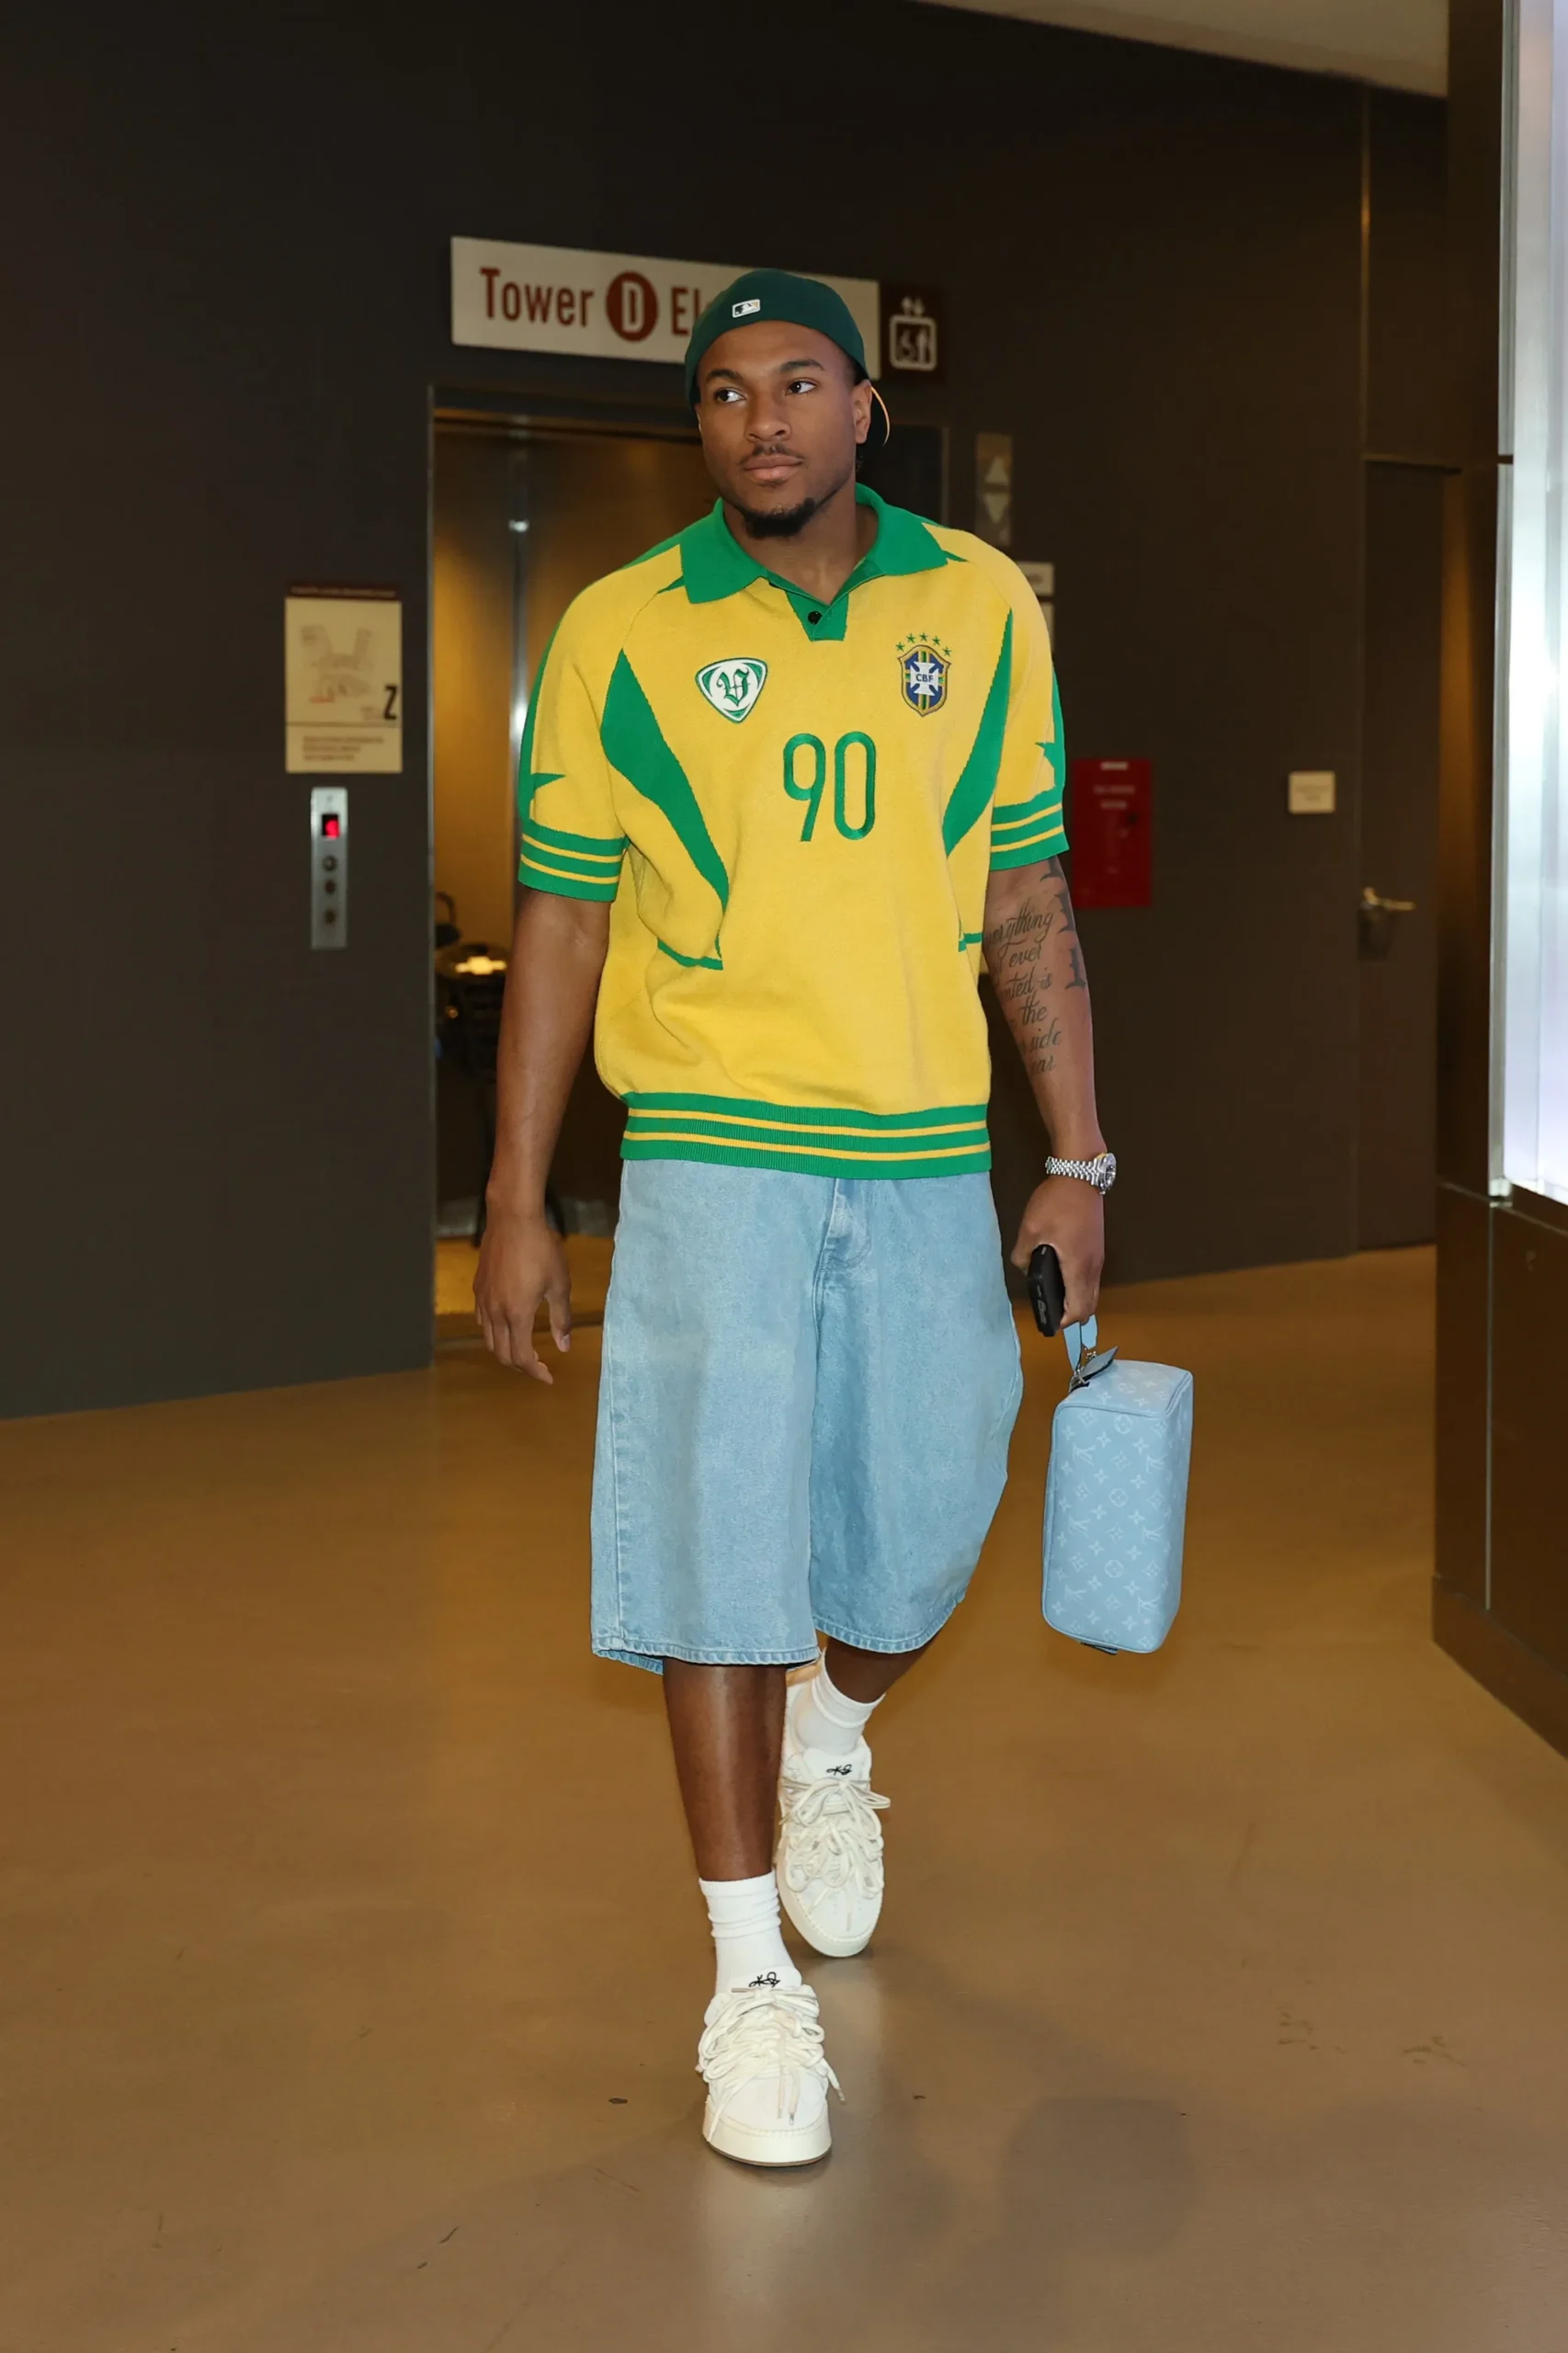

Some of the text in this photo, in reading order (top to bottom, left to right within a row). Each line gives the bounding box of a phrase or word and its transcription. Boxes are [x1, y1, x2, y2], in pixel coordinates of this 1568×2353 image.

[480, 267, 702, 336] Tower D El
[915, 673, 934, 683] CBF
[783, 731, 877, 842] 90
[1018, 990, 1048, 1026] the
